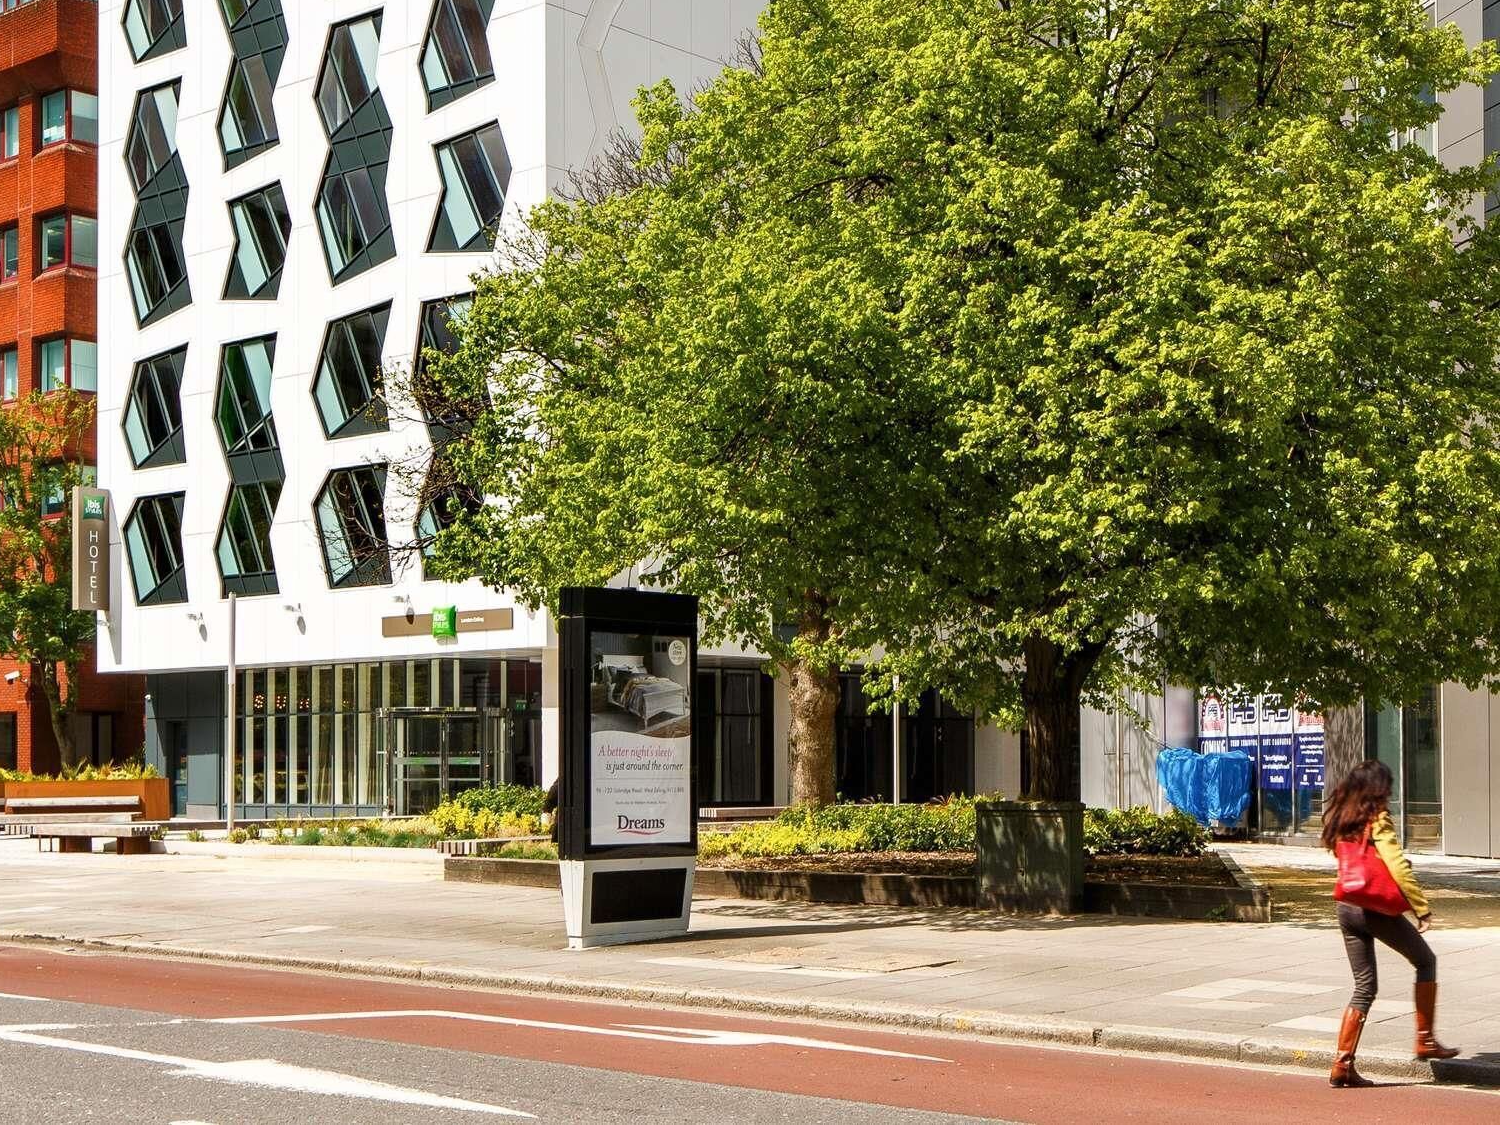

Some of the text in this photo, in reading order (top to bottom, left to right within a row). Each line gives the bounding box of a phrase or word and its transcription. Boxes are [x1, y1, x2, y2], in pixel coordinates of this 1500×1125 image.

[89, 530, 99, 604] HOTEL
[598, 745, 605, 756] A
[607, 745, 629, 756] better
[630, 745, 654, 761] night's
[606, 761, 611, 770] is
[610, 761, 625, 774] just
[625, 760, 650, 770] around
[651, 760, 661, 770] the
[617, 814, 665, 829] Dreams
